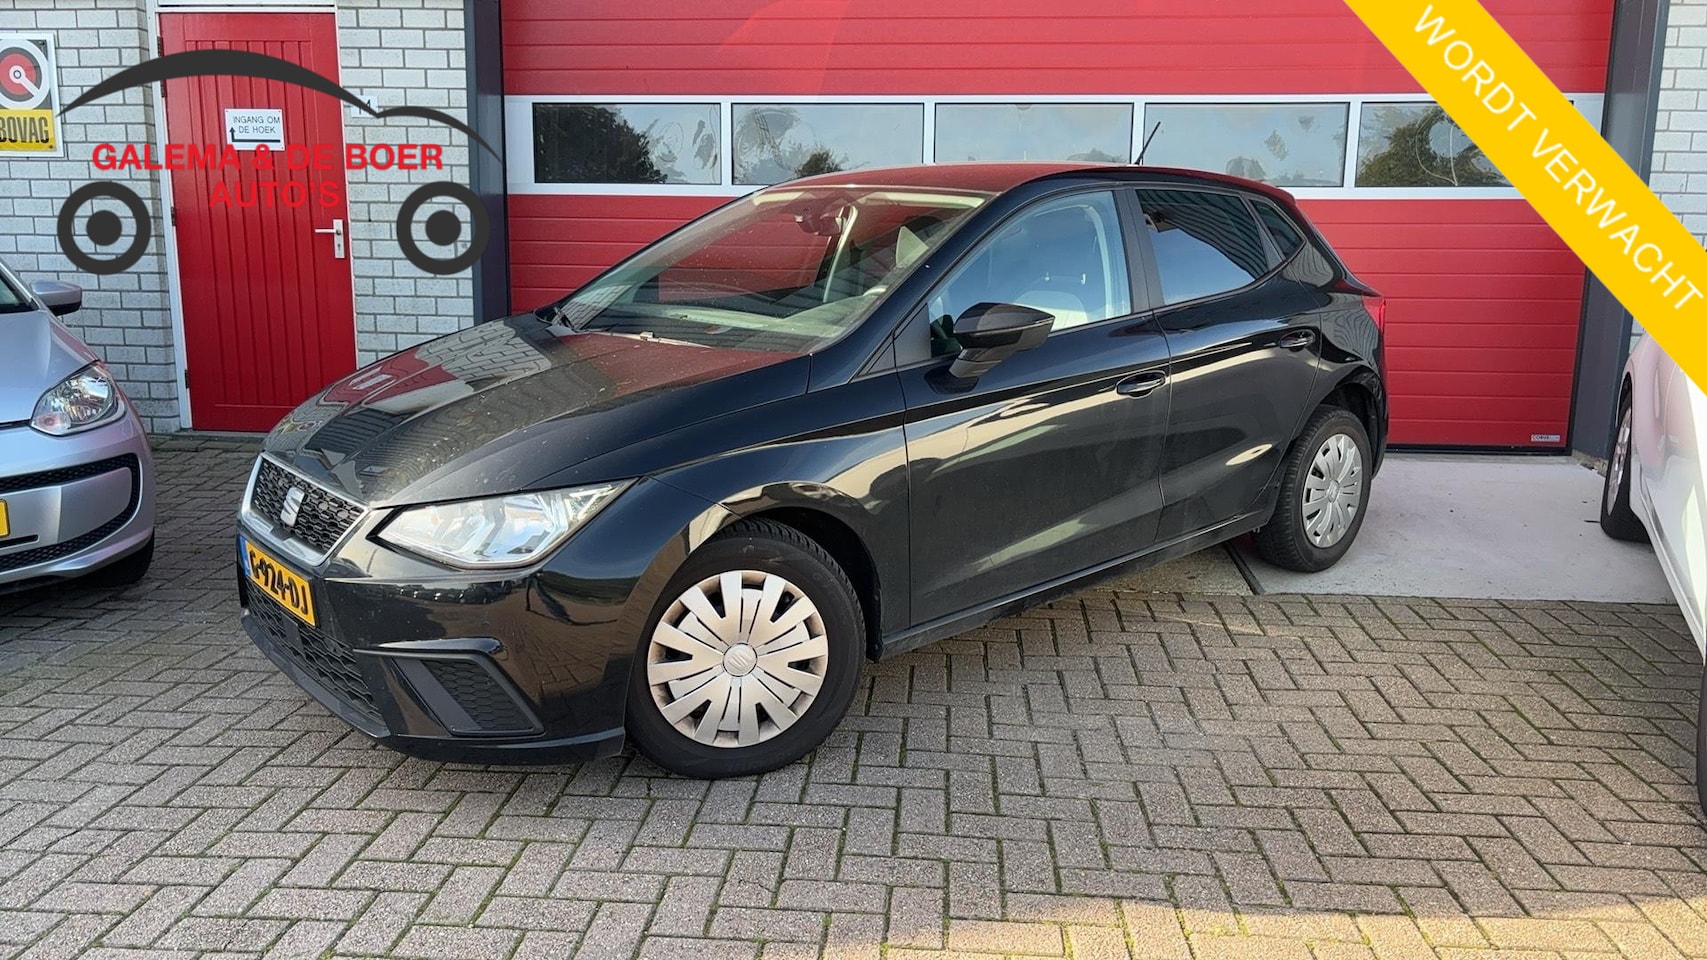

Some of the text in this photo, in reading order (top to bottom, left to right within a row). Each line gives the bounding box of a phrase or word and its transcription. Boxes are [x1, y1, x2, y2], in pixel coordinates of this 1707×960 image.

[232, 115, 281, 124] INGANG OM
[0, 116, 49, 144] BOVAG
[238, 125, 277, 134] DE HOEK
